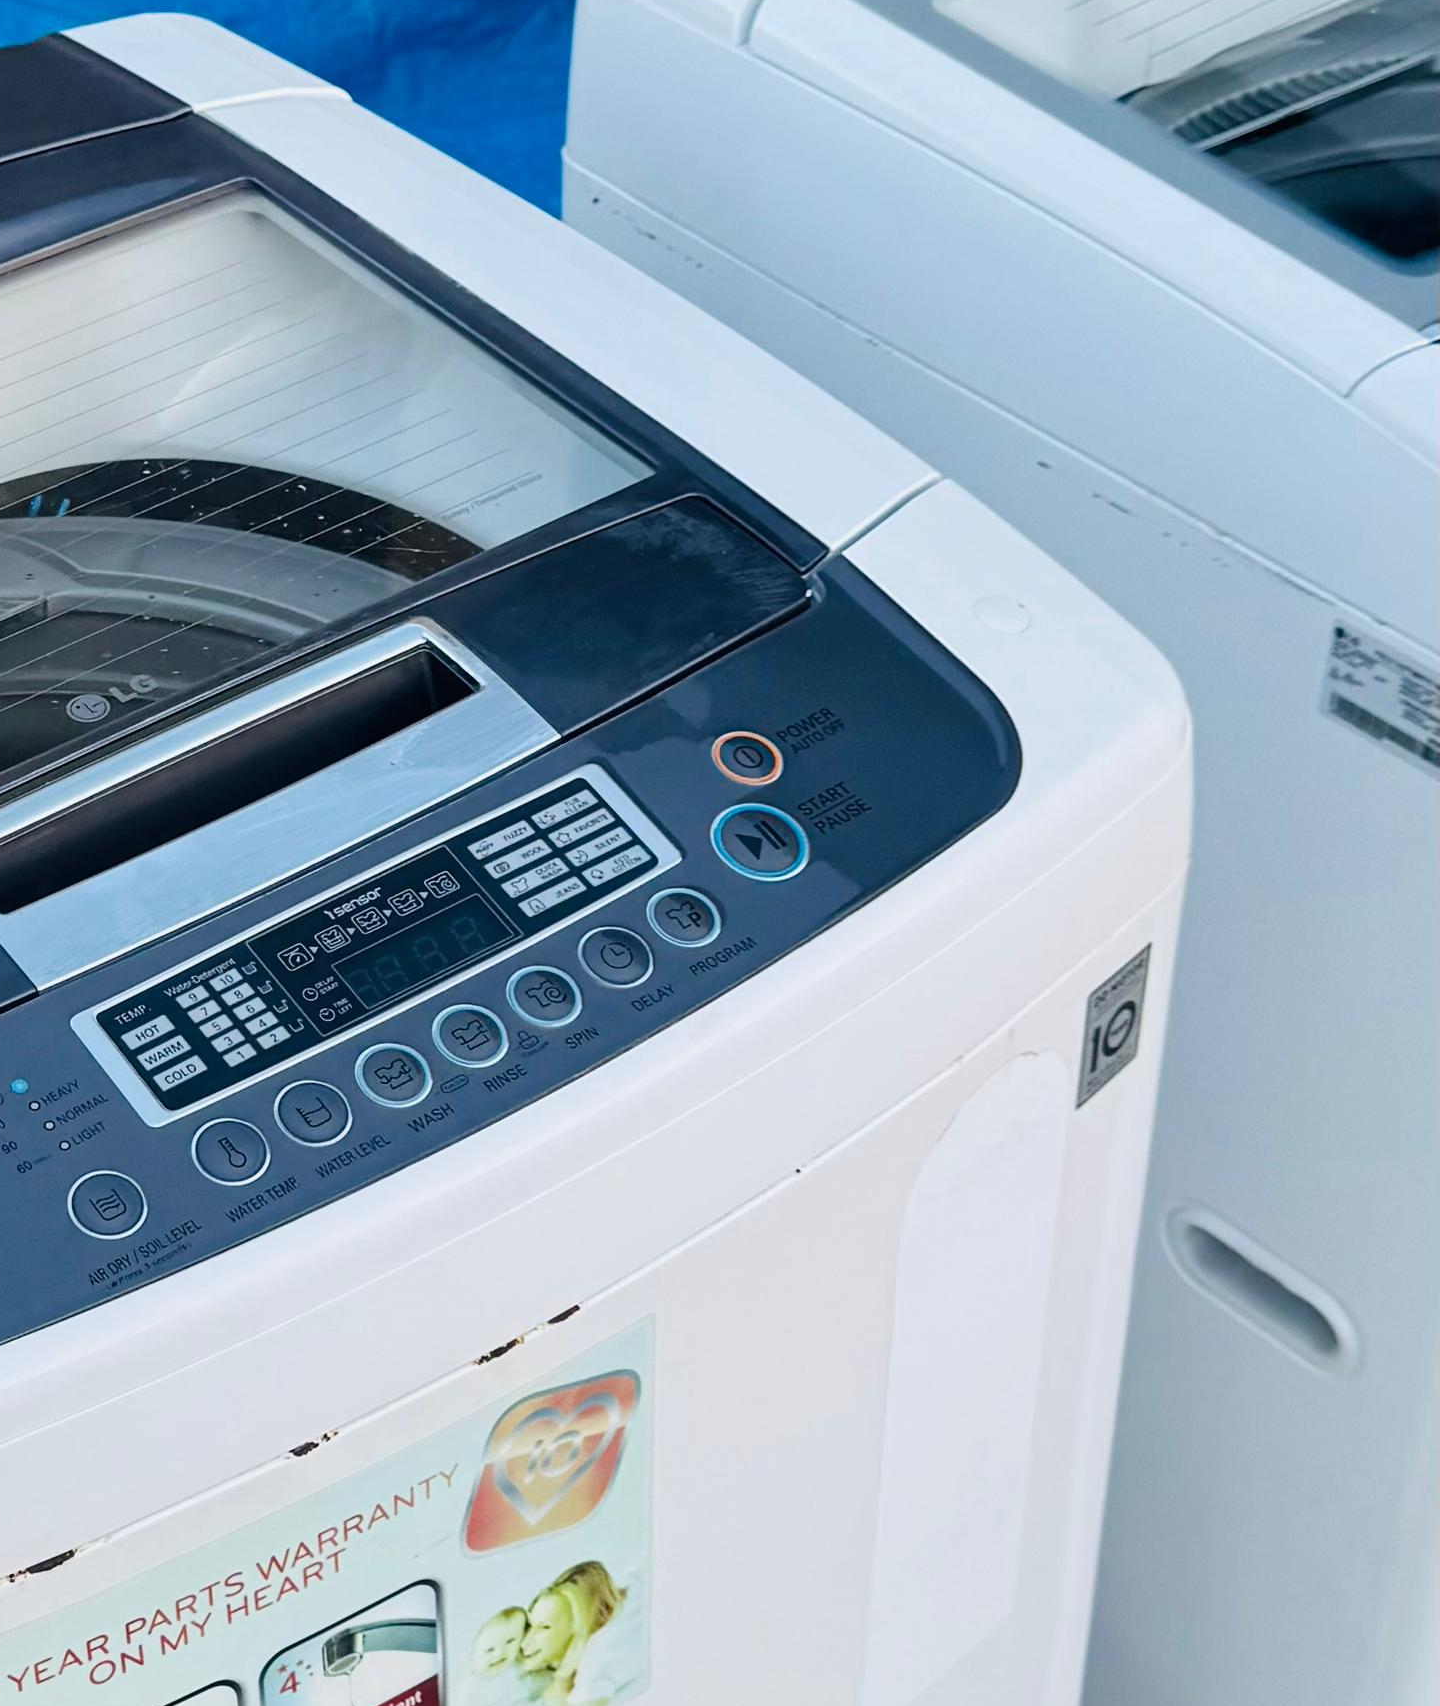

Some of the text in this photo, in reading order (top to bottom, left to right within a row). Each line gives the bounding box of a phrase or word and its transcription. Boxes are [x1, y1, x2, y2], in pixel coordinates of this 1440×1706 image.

[108, 674, 160, 704] LG
[776, 707, 837, 744] POWER
[790, 732, 826, 755] AUTO
[798, 781, 852, 816] START
[813, 798, 873, 835] PAUSE
[688, 936, 759, 977] PROGRAM
[188, 974, 234, 1002] 9 10
[631, 983, 676, 1013] DELAY
[114, 1004, 152, 1026] TEMP.
[200, 990, 244, 1016] 7 8
[211, 1004, 255, 1032] 5 6
[224, 1018, 267, 1046] 3 4
[135, 1024, 160, 1043] HOT
[236, 1033, 279, 1060] 1 2
[564, 1026, 600, 1051] SPIN
[144, 1041, 184, 1066] WARM
[164, 1063, 197, 1086] COLD
[483, 1063, 528, 1093] RINSE
[41, 1079, 80, 1107] HEAVY
[56, 1093, 109, 1126] NORMAL
[407, 1103, 456, 1135] WASH
[1, 1140, 18, 1155] 90
[70, 1121, 108, 1146] LIGHT
[16, 1160, 33, 1174] 60
[315, 1134, 392, 1179] WATER LEVEL
[225, 1194, 268, 1224] WATER
[88, 1267, 110, 1286] AIR
[107, 1252, 132, 1275] DRY
[138, 1237, 168, 1259] SOIL
[165, 1219, 202, 1245] LEVEL
[8, 1633, 110, 1695] YEAR
[124, 1571, 246, 1647] PARTS
[255, 1462, 460, 1582] WARRANTY
[89, 1548, 348, 1687] ON MY HEART
[279, 1670, 301, 1695] 4
